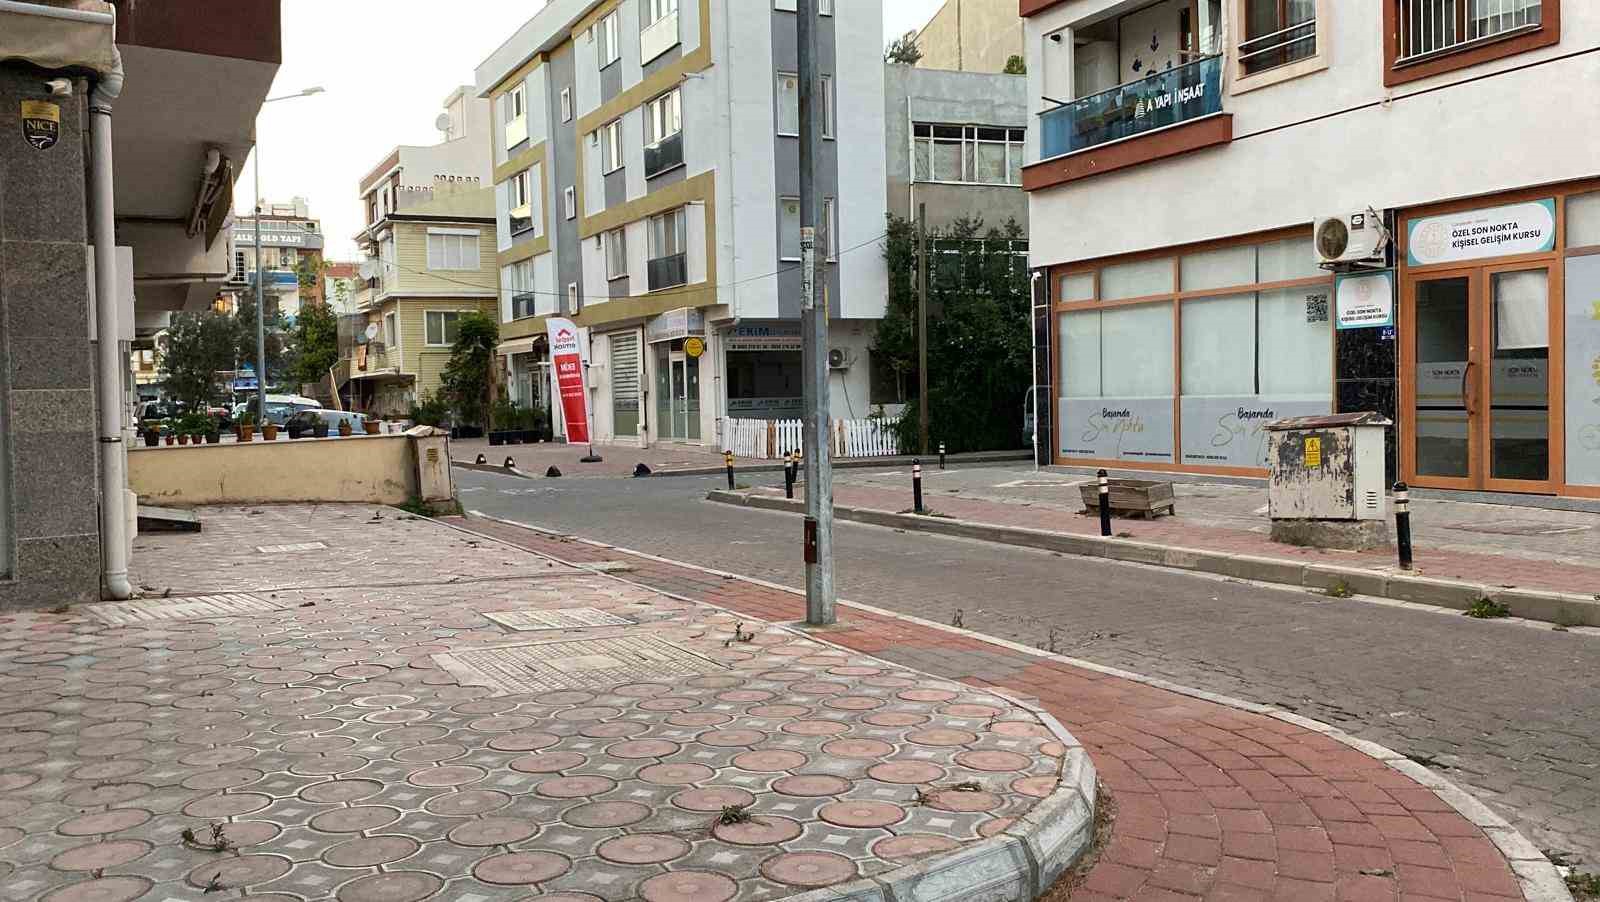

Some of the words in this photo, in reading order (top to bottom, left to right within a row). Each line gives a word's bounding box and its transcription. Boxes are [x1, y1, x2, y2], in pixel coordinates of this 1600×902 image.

[1154, 92, 1172, 109] YAPI
[1174, 82, 1205, 104] İNŞAAT
[1451, 229, 1471, 238] ÖZEL
[1471, 226, 1489, 235] SON
[1489, 221, 1519, 233] NOKTA
[1452, 239, 1480, 250] KİŞİSEL
[1480, 233, 1512, 246] GELİŞİM
[1513, 229, 1541, 241] KURSU
